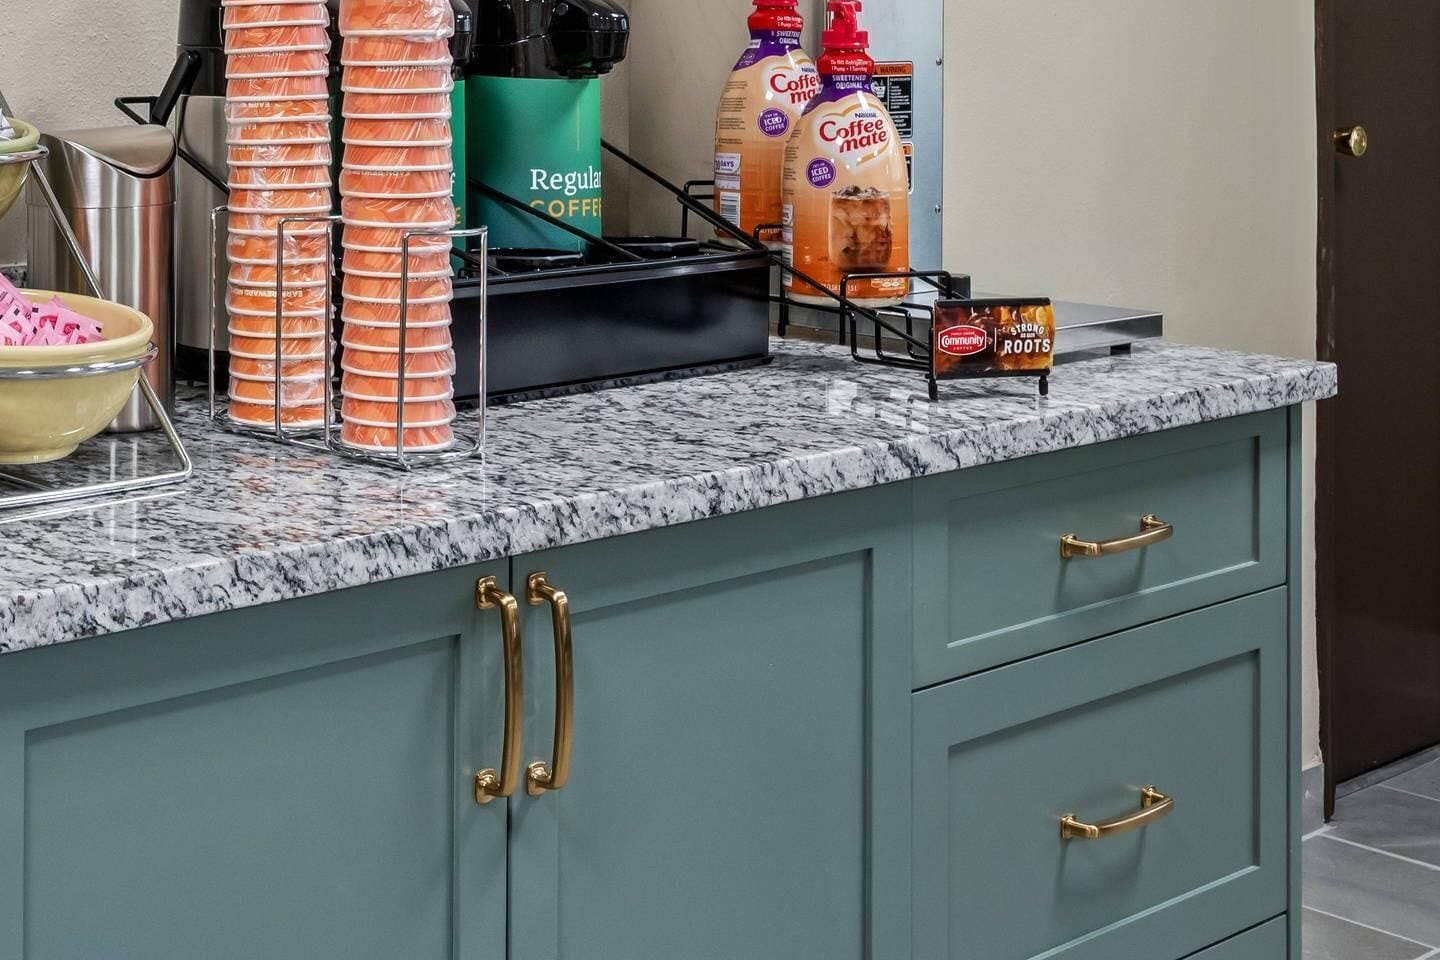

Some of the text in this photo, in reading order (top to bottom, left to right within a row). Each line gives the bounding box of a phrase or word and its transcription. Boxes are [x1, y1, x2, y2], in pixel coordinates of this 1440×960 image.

[832, 74, 867, 82] SWEETENED
[790, 88, 816, 105] ma
[764, 117, 782, 126] ICED
[765, 123, 785, 132] COFFEE
[819, 119, 885, 142] Coffee
[839, 130, 887, 153] mate
[721, 160, 735, 168] DAYS
[811, 166, 829, 176] ICED
[812, 174, 831, 183] COFFEE
[1011, 323, 1045, 336] STRONG
[941, 335, 985, 347] Community
[1004, 338, 1051, 354] ROOTS
